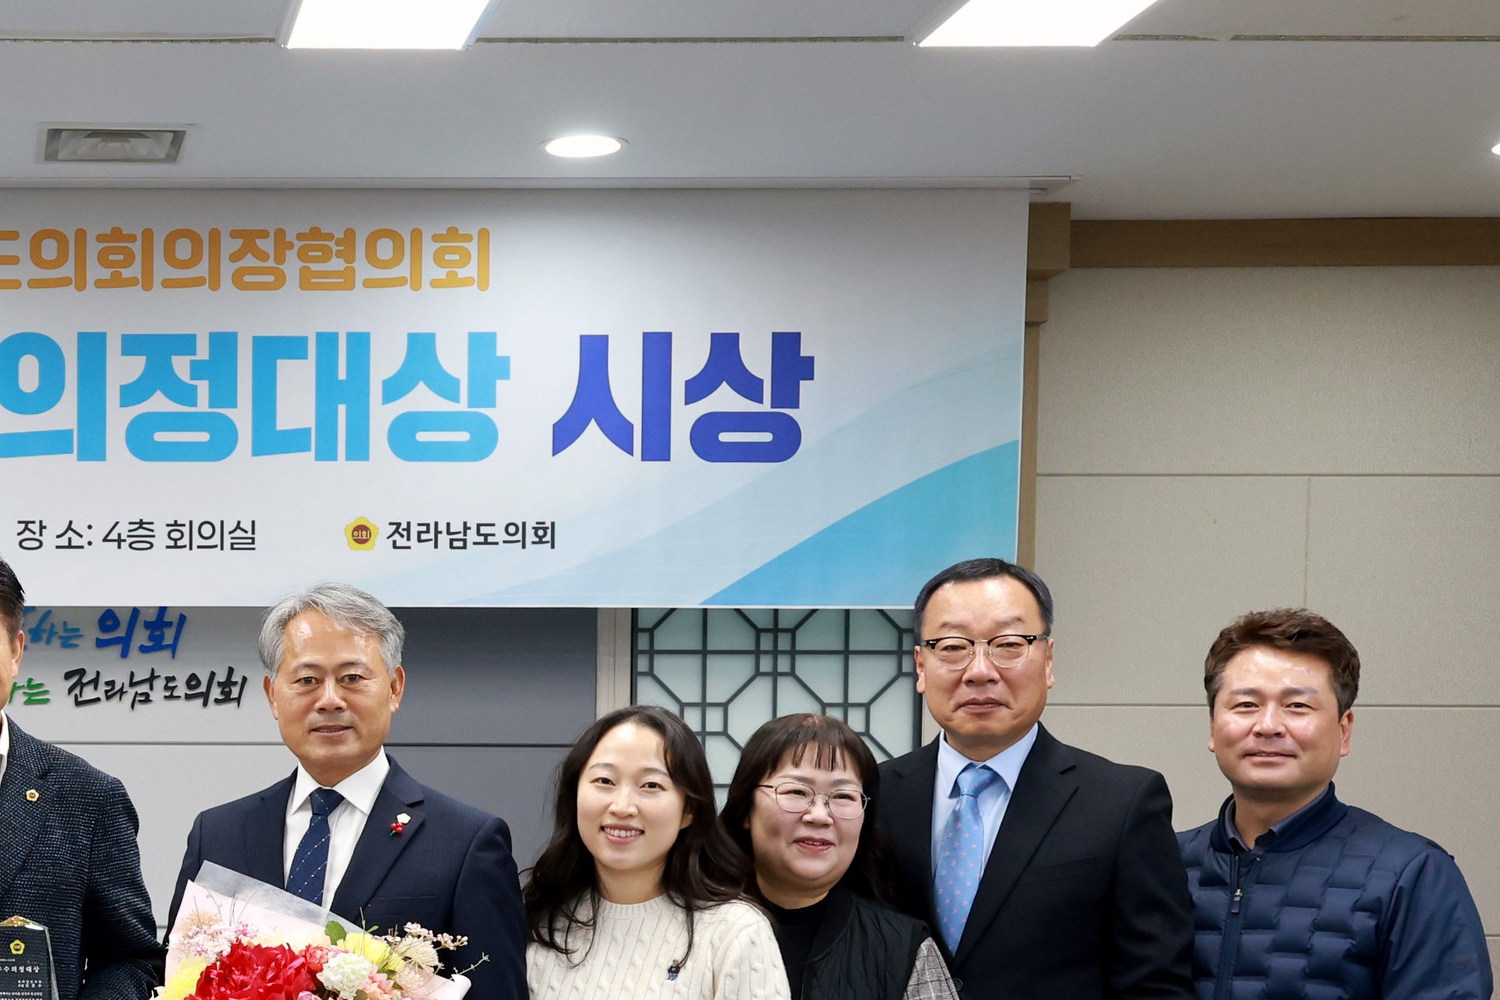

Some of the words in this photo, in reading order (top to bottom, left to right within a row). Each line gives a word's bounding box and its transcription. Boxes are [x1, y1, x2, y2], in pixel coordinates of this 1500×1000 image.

[552, 331, 815, 464] 시상
[101, 518, 156, 550] 4층
[165, 518, 257, 551] 회의실
[386, 519, 557, 551] 전라남도의회
[94, 606, 188, 660] 의회
[63, 666, 248, 711] 전라남도의회
